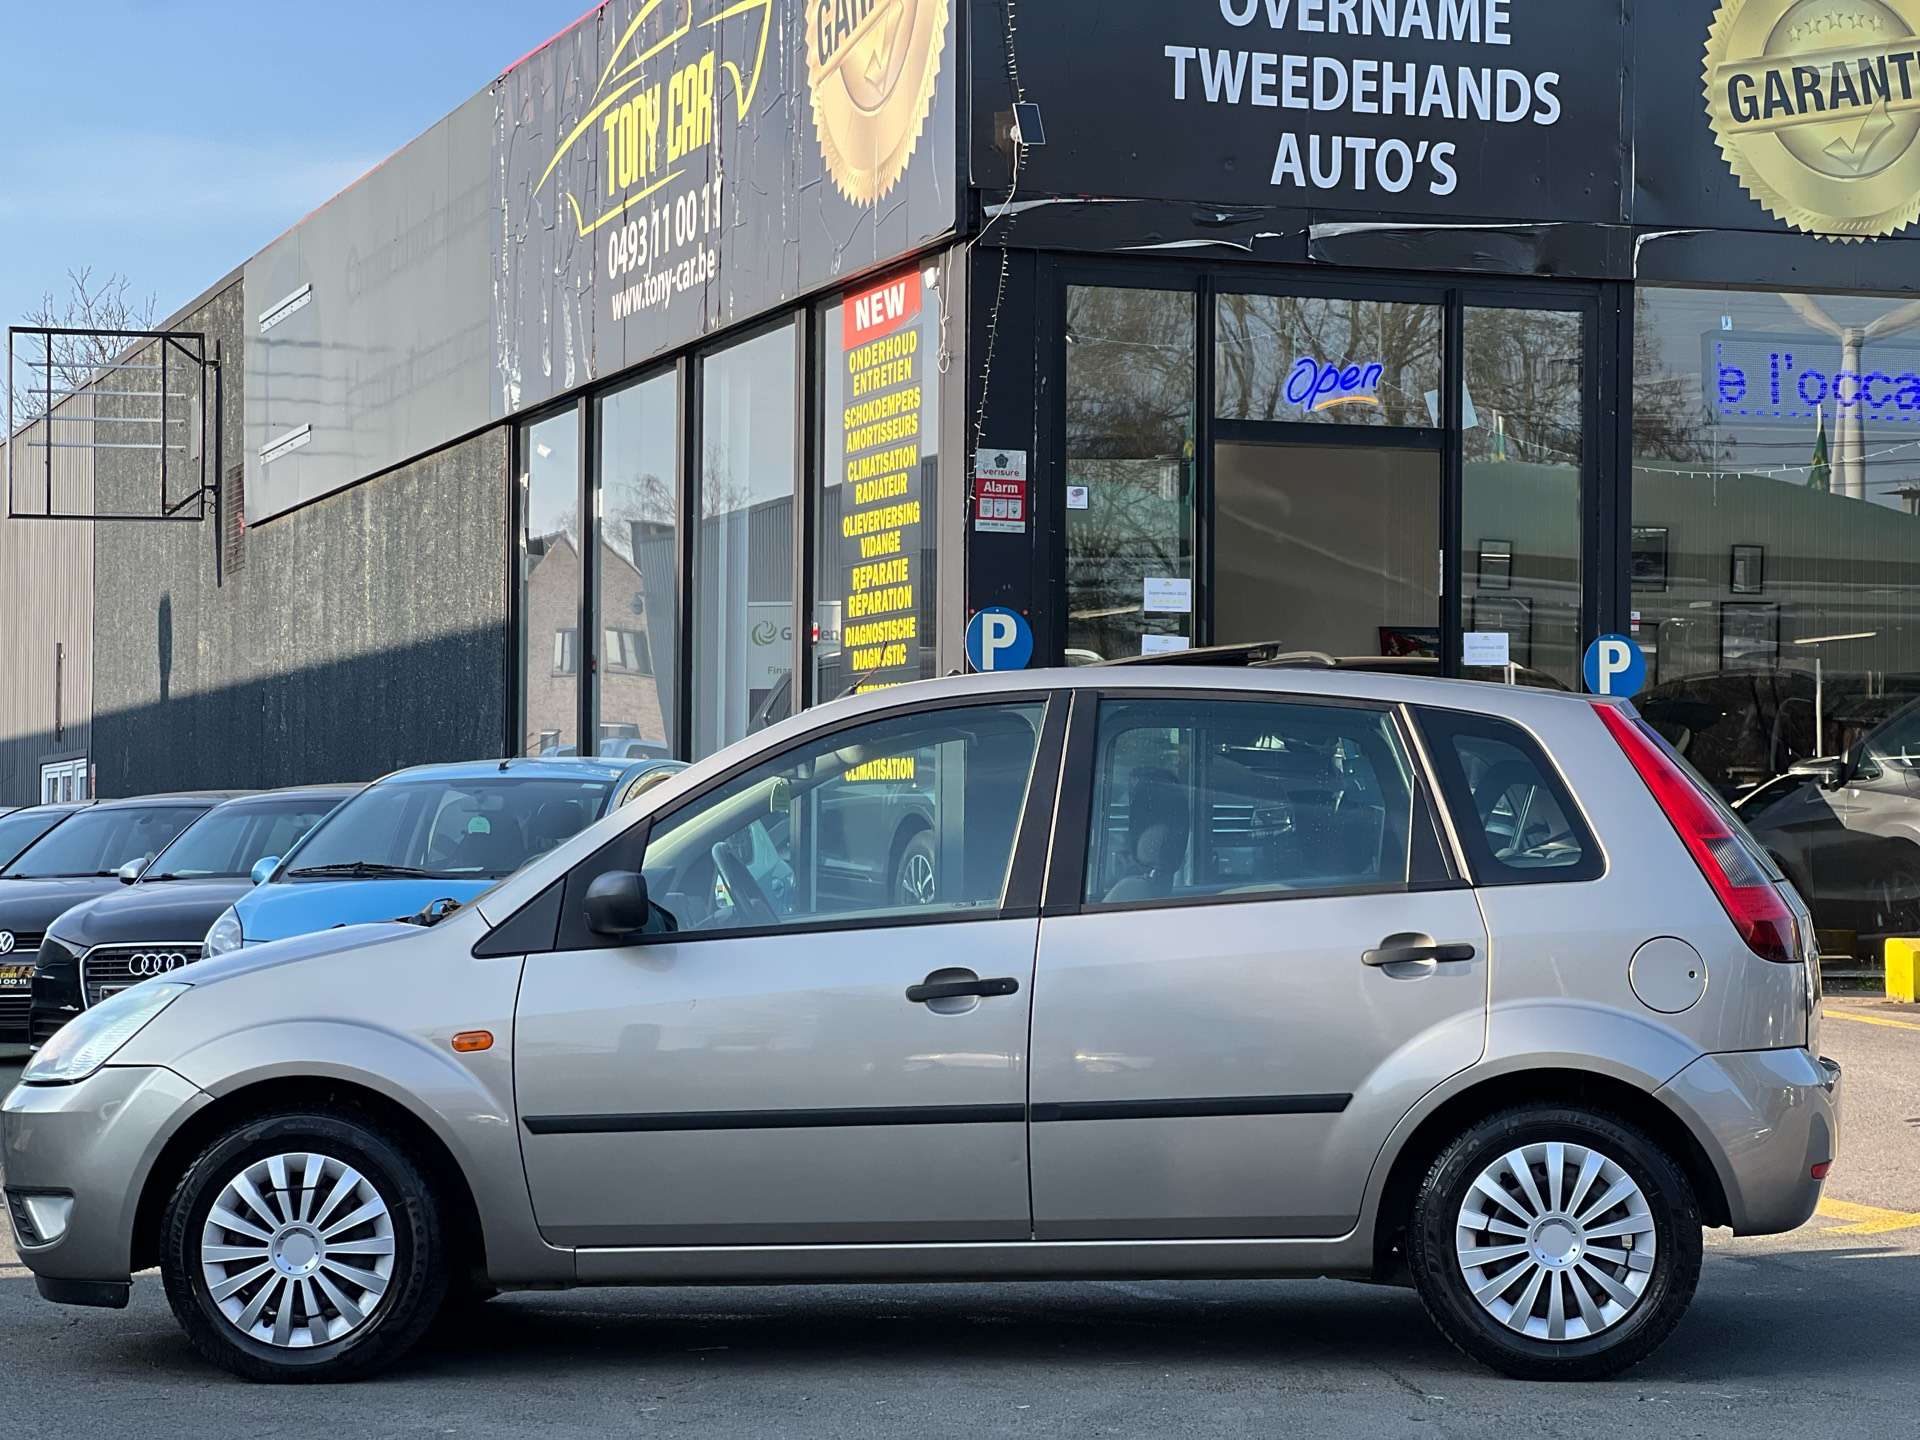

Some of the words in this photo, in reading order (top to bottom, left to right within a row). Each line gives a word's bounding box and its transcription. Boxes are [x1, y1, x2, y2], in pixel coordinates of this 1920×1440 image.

[1165, 46, 1561, 125] TWEEDEHANDS
[603, 82, 661, 197] TONY
[668, 50, 715, 164] CAR
[1270, 132, 1457, 195] AUTO'S
[675, 190, 697, 247] 00
[612, 242, 715, 321] www.tony-car.be
[856, 283, 906, 331] NEW
[849, 331, 917, 373] ONDERHOUD
[853, 357, 912, 396] ENTRETIEN
[1286, 357, 1384, 410] Open
[844, 387, 920, 429] SCHOKDEMPERS
[846, 413, 917, 453] AMORTISSEURS
[847, 444, 917, 482] CLIMATISATION
[855, 472, 907, 505] RADIATEUR
[983, 480, 1019, 494] Alarm
[843, 500, 920, 537] OLIEVERVERSING
[861, 530, 900, 558] VIDANGE
[852, 558, 909, 591] REPARATIE
[848, 585, 912, 618] RÉPARATION
[845, 617, 916, 647] DIAGNOSTISCHE
[982, 613, 1017, 670] P
[853, 643, 907, 671] DIAGNOSTIC
[1599, 640, 1631, 694] P
